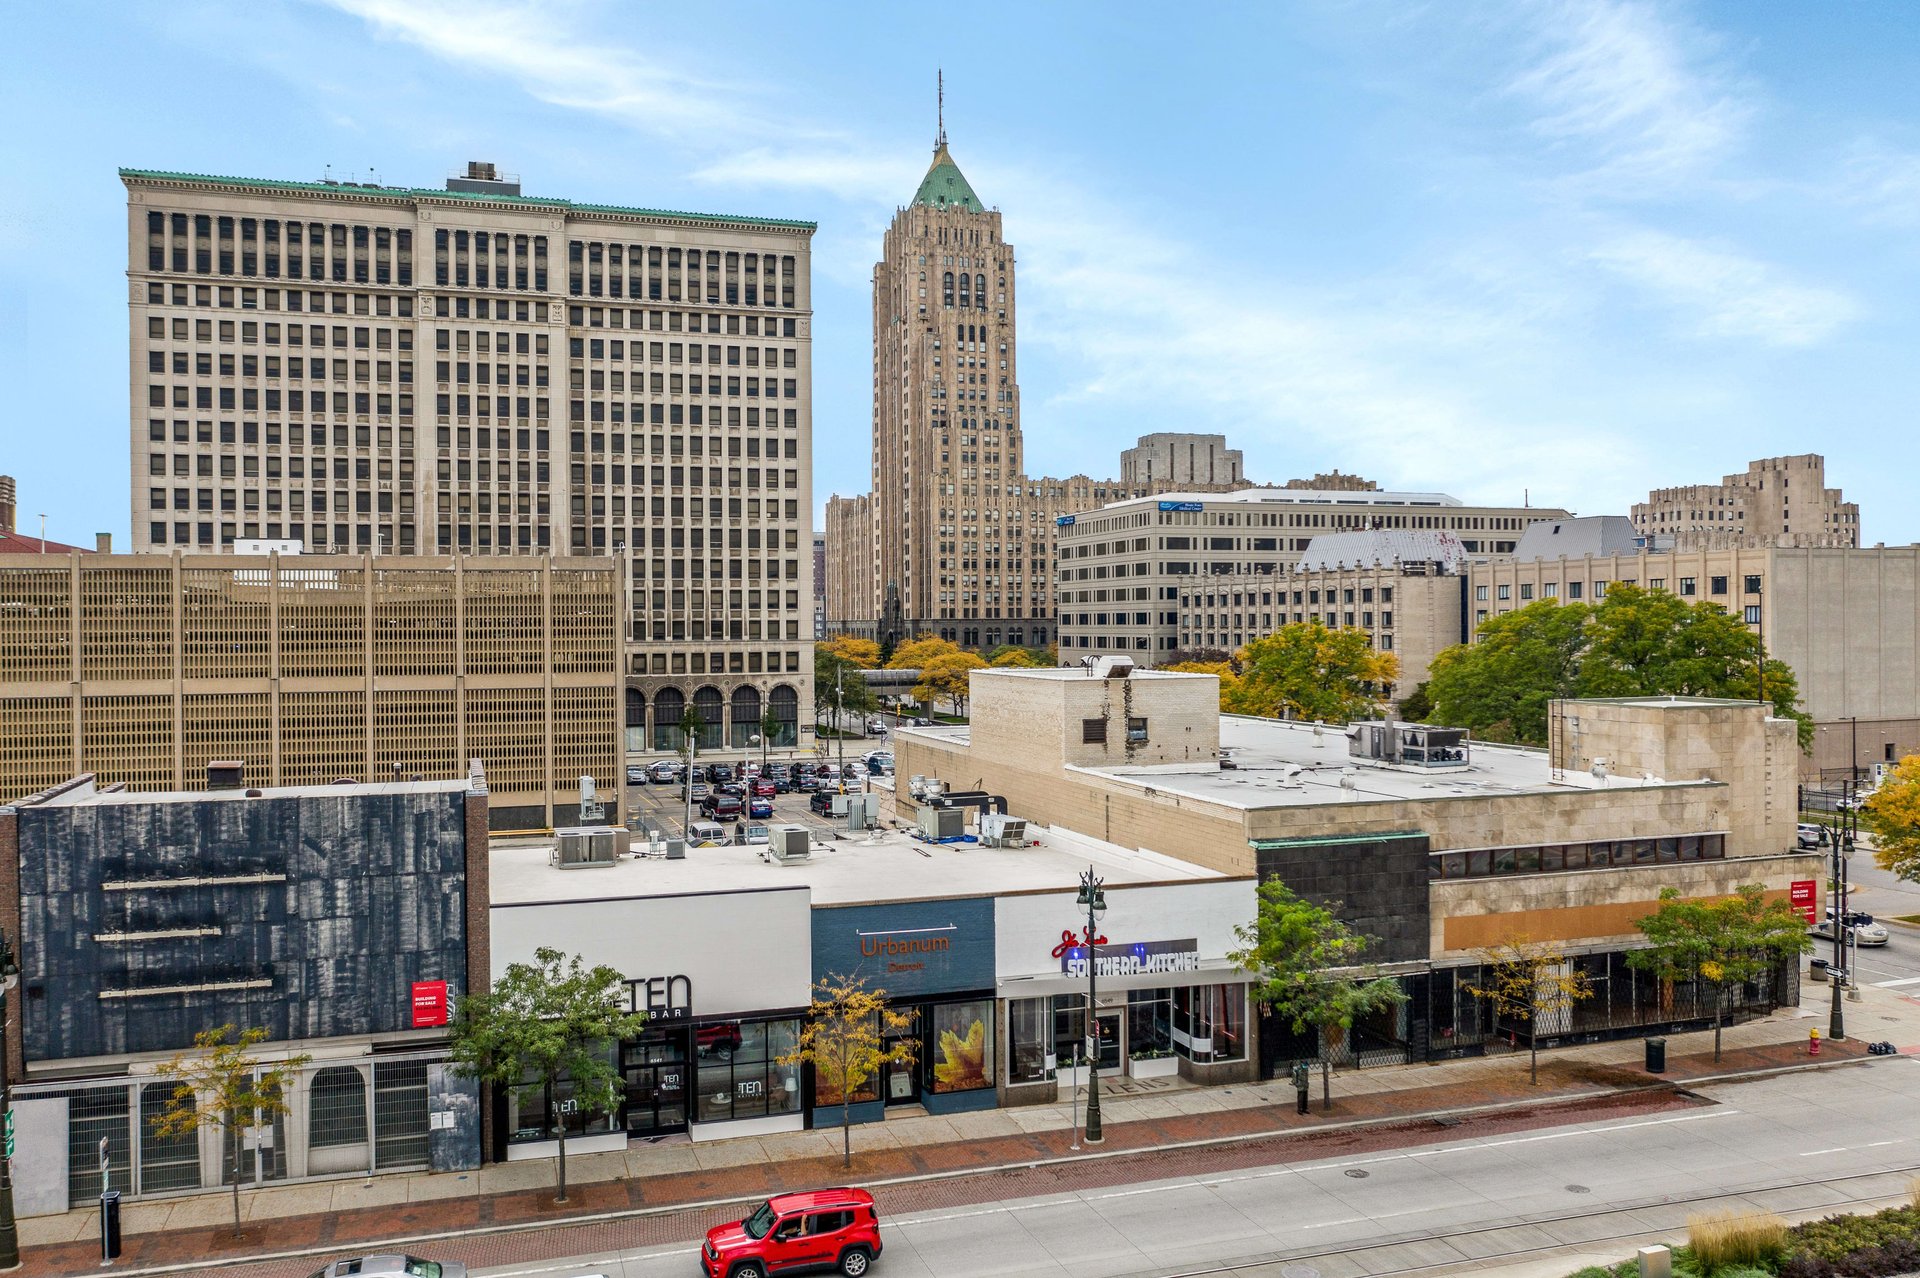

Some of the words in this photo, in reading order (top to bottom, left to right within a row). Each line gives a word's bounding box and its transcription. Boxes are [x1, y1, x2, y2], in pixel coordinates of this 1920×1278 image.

[861, 935, 949, 956] Urbanum
[1145, 951, 1201, 973] KITCHEN
[650, 1009, 681, 1019] BAR
